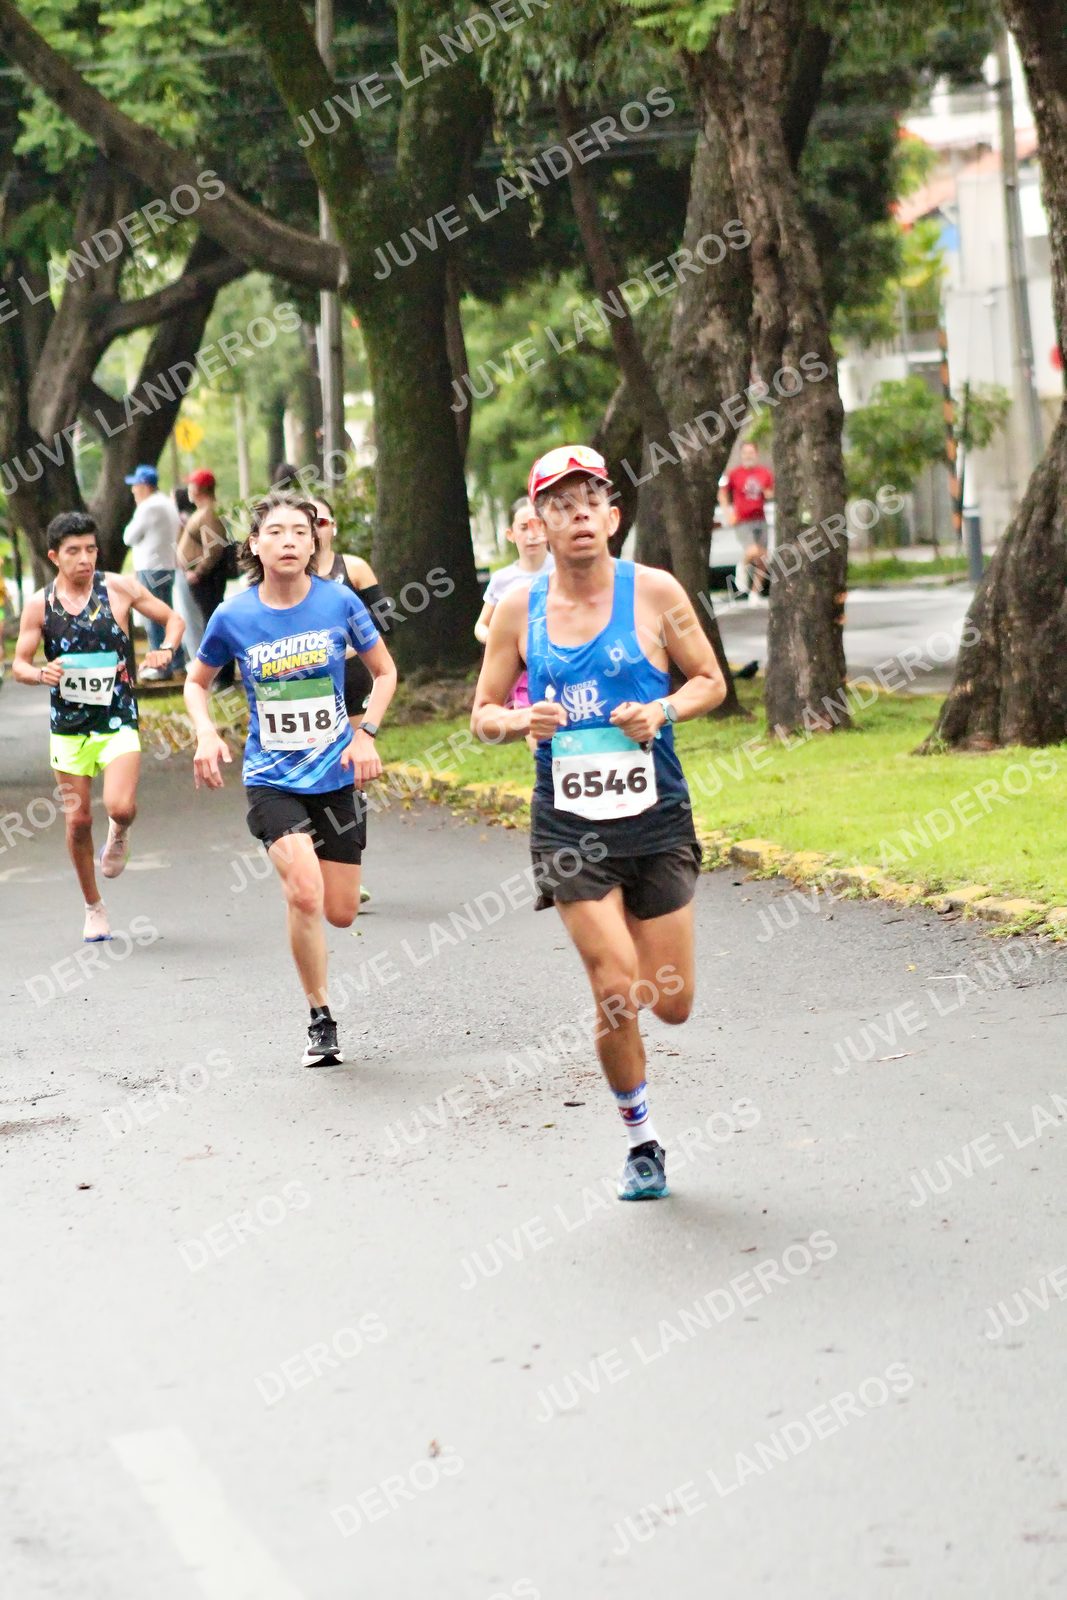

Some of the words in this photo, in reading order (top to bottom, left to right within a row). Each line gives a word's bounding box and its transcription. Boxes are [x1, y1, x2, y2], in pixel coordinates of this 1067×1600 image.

[248, 631, 328, 670] TOCHITOS
[262, 649, 326, 678] RUNNERS
[64, 676, 114, 692] 4197
[265, 709, 332, 734] 1518
[562, 767, 648, 800] 6546
